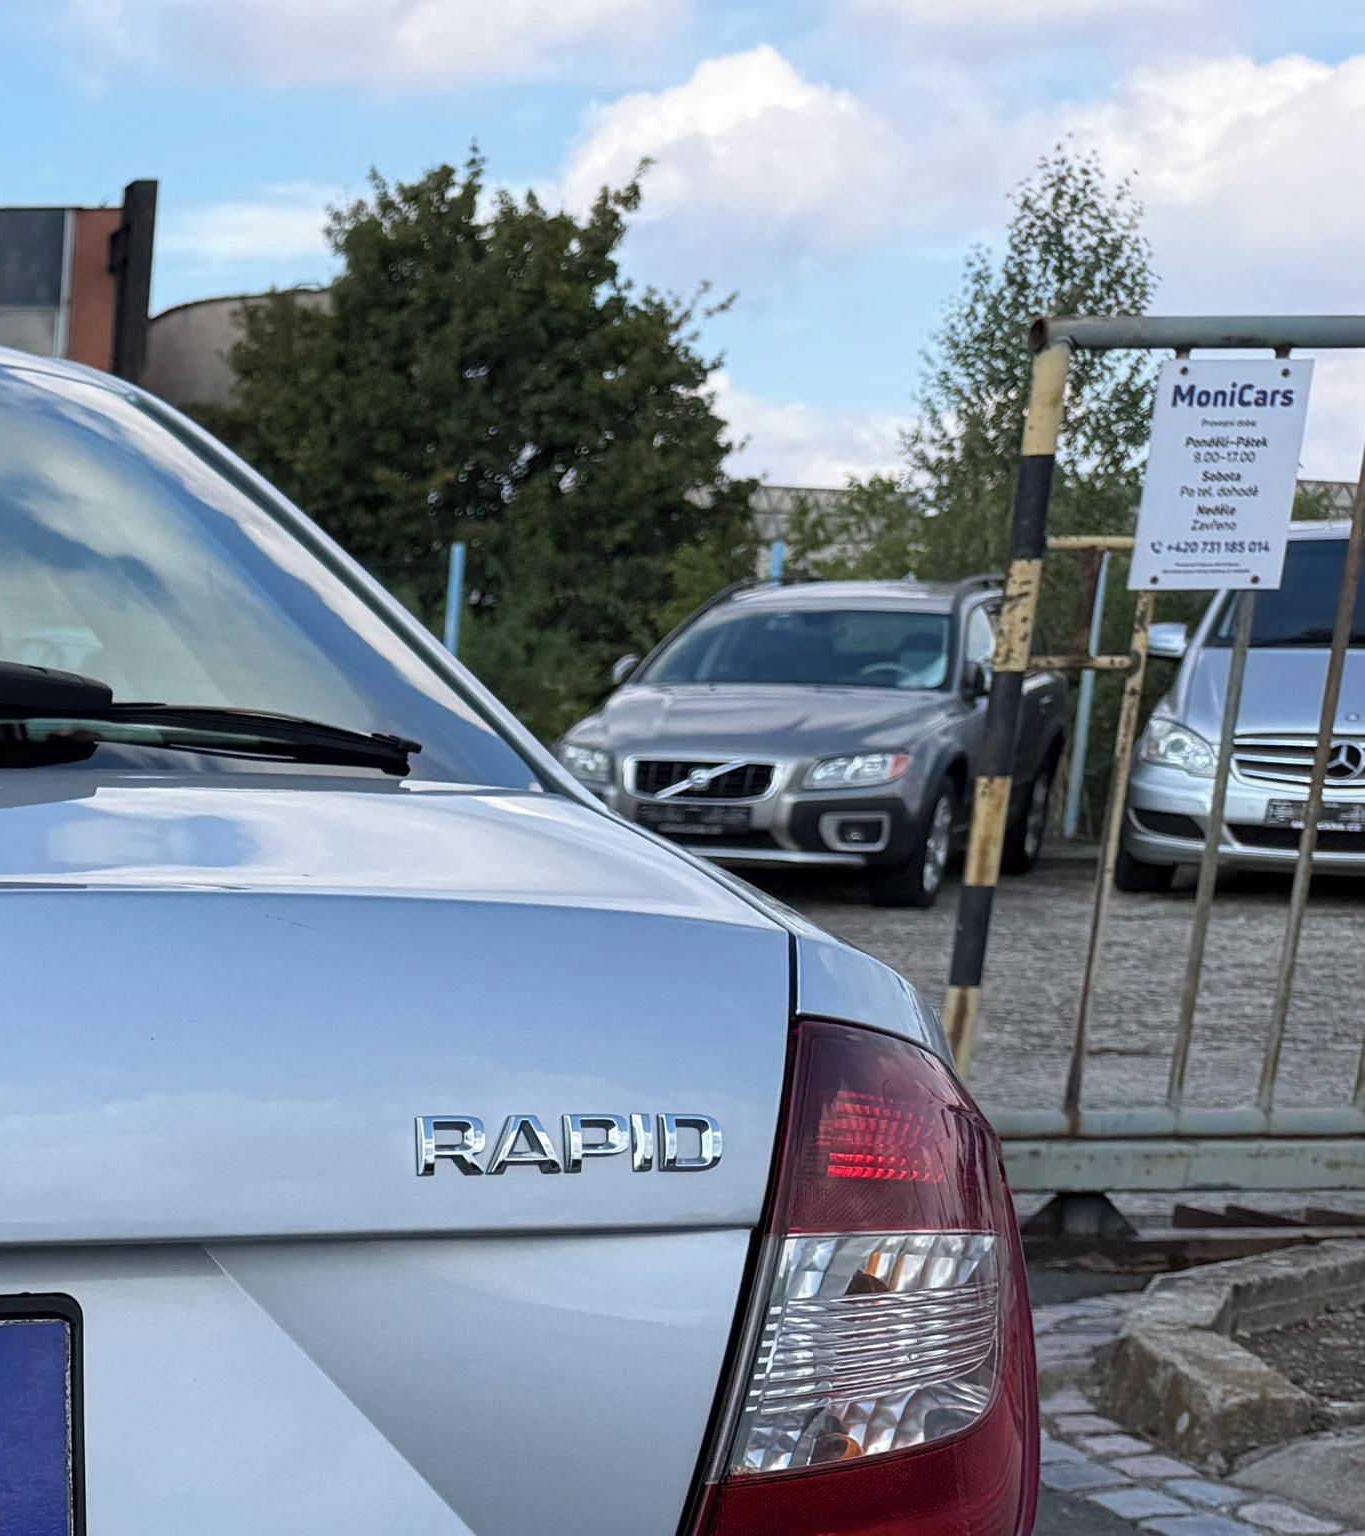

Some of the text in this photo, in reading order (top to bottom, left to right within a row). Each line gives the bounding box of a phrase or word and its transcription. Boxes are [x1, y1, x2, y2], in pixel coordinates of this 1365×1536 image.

[1171, 381, 1295, 408] MoniCars
[1201, 470, 1242, 482] Sobota
[1195, 503, 1237, 516] Neděle
[1190, 518, 1237, 531] Zavřeno
[1167, 540, 1199, 554] +420
[1201, 540, 1222, 554] 731
[415, 1113, 723, 1176] RAPID
